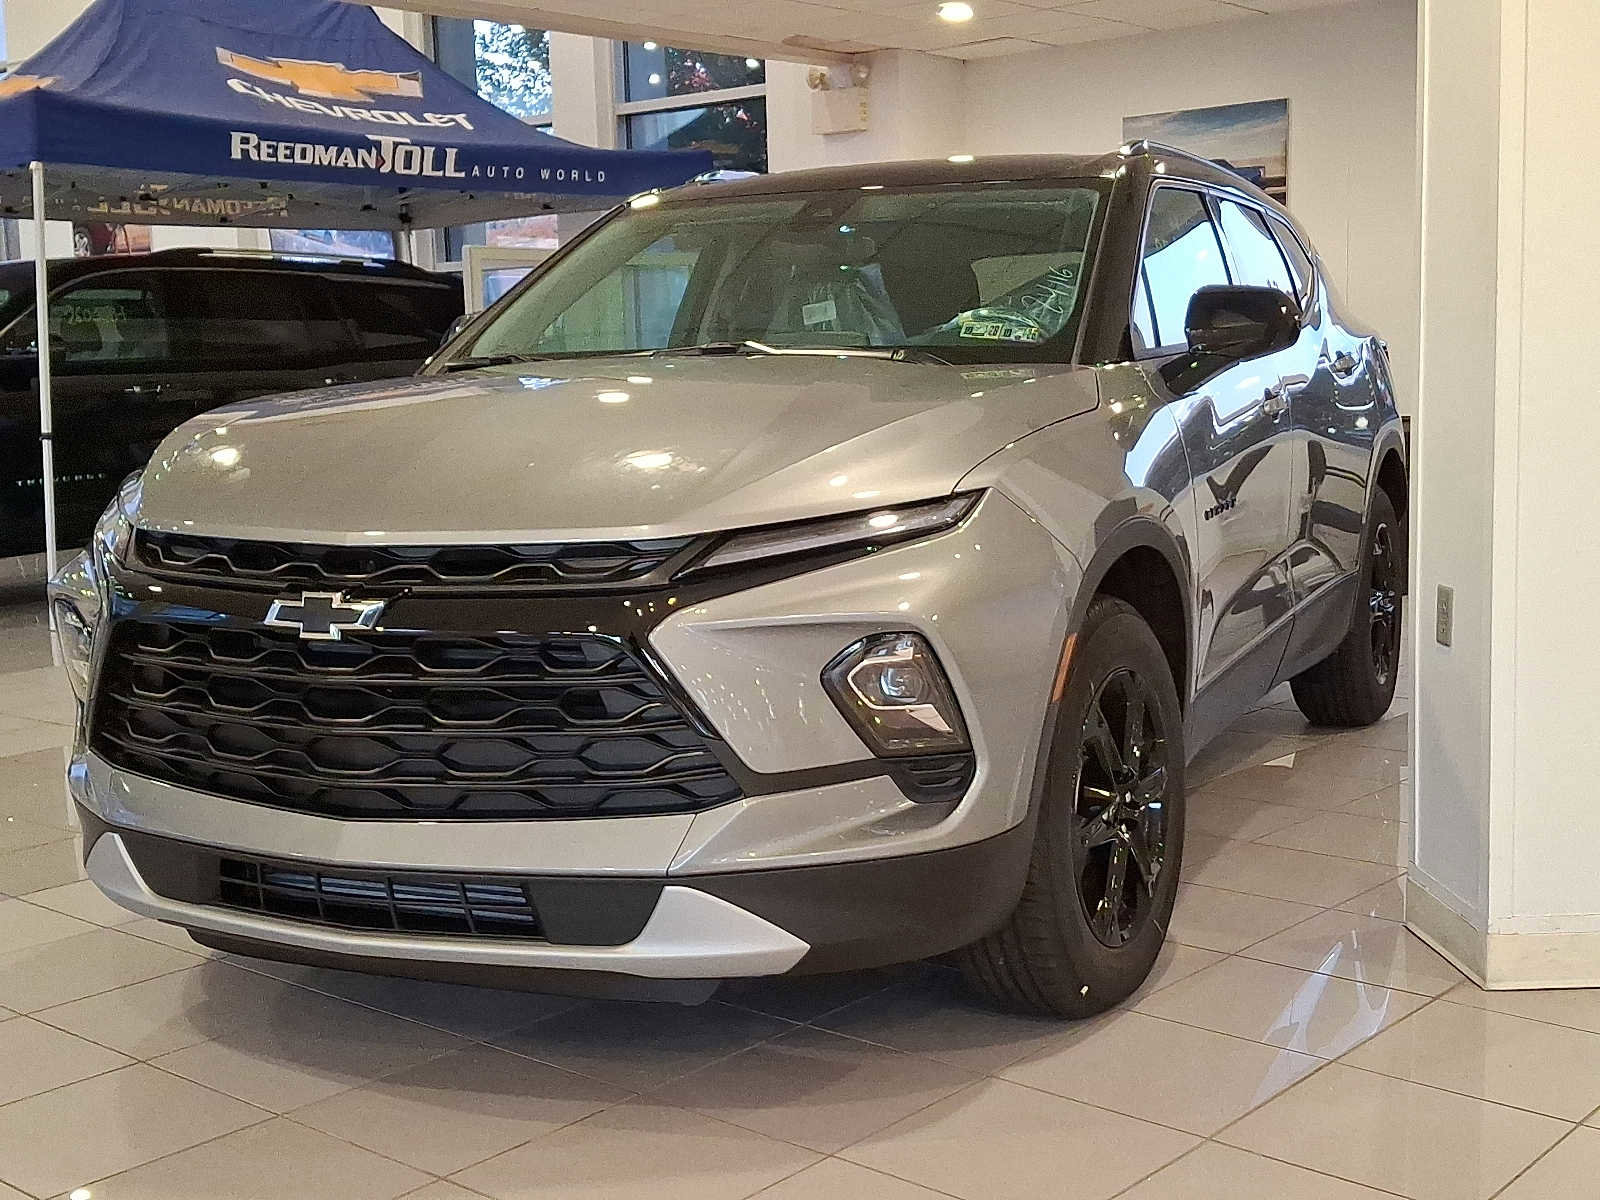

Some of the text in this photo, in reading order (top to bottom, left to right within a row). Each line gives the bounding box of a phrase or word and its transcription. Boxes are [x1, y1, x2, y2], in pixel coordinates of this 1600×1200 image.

[226, 78, 475, 131] CHEVROLET
[229, 131, 606, 183] REEDMAN TOLL AUTO WORLD
